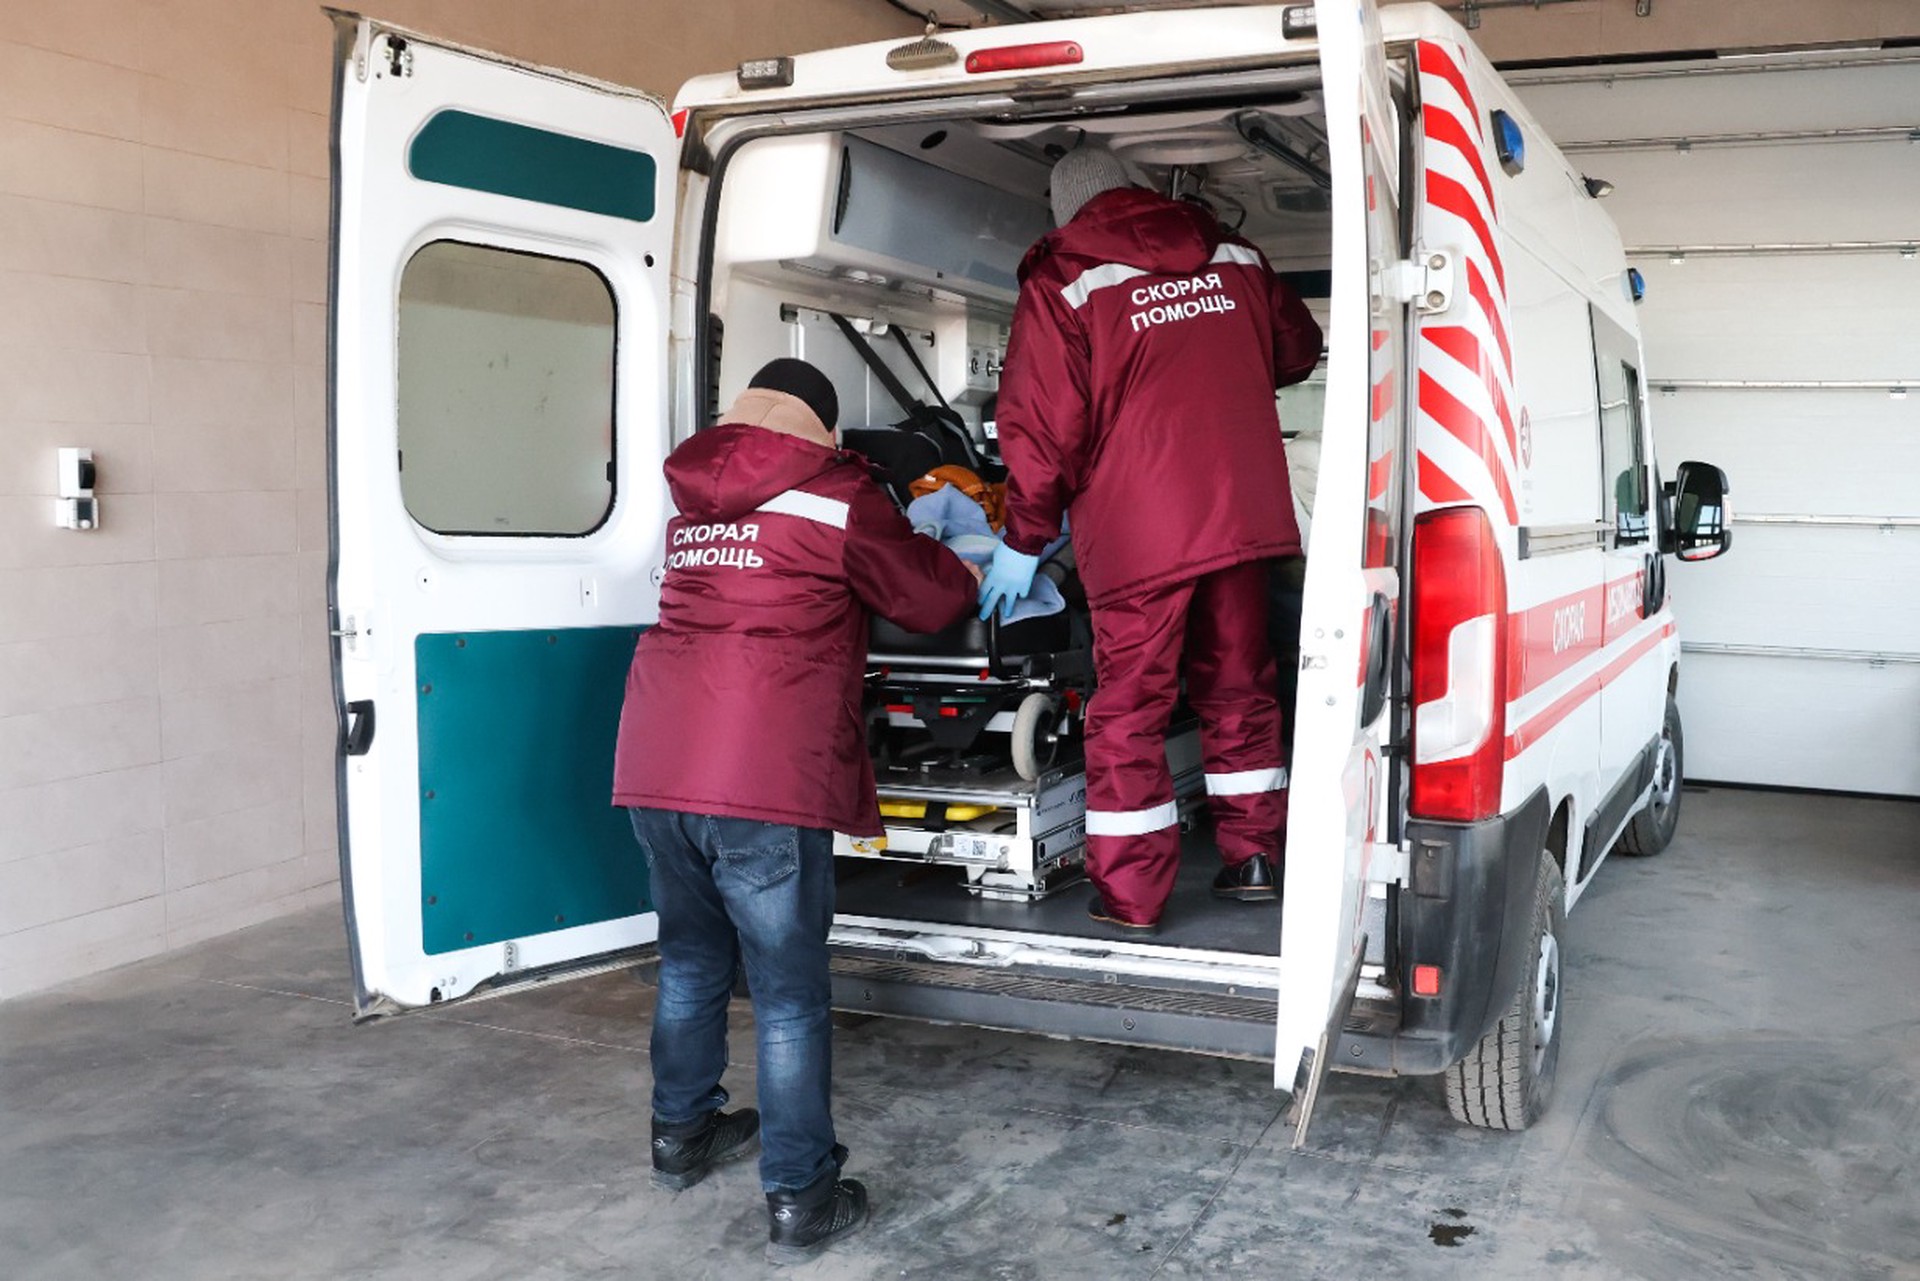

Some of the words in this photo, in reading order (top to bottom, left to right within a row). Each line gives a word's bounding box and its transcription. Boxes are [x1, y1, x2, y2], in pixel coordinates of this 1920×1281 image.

[1131, 273, 1222, 305] СКОРАЯ
[1130, 294, 1236, 332] ПОМОЩЬ
[673, 523, 760, 546] СКОРАЯ
